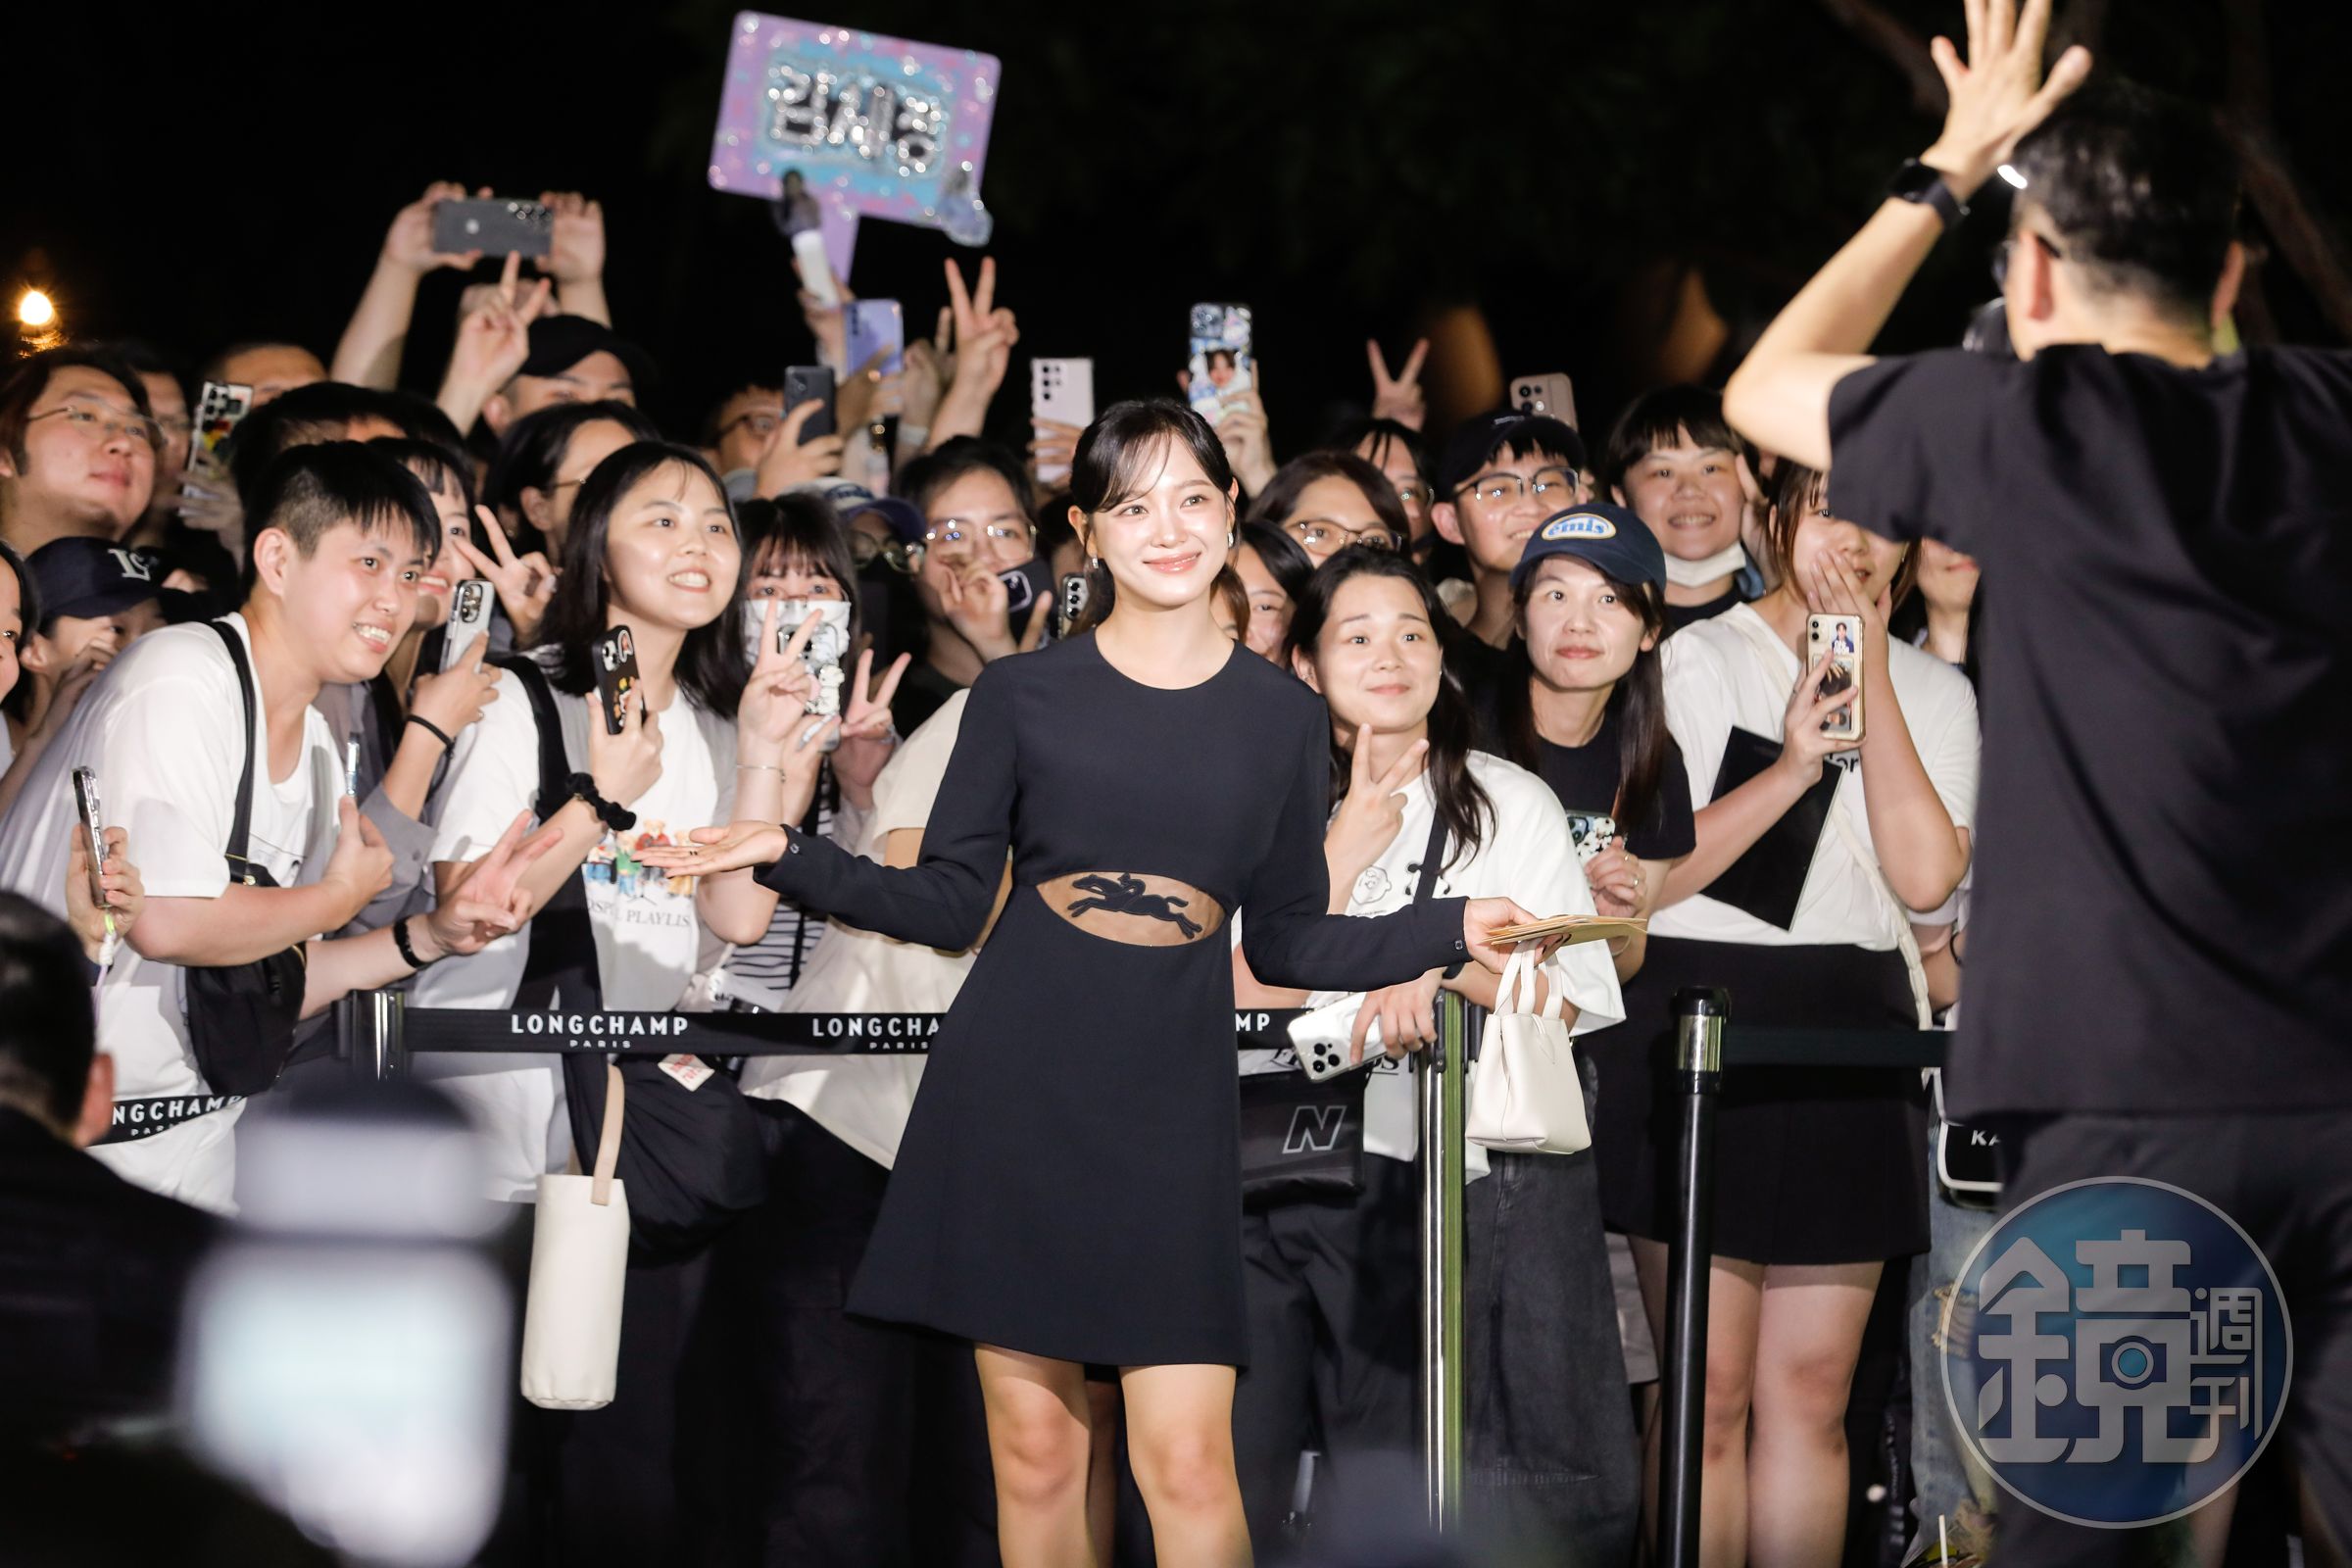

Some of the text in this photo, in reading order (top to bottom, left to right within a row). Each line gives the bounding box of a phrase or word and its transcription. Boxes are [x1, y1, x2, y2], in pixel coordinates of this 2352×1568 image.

[1547, 517, 1605, 536] emis
[512, 1014, 688, 1035] LONGCHAMP
[569, 1040, 631, 1049] PARIS
[1282, 1105, 1348, 1154] N
